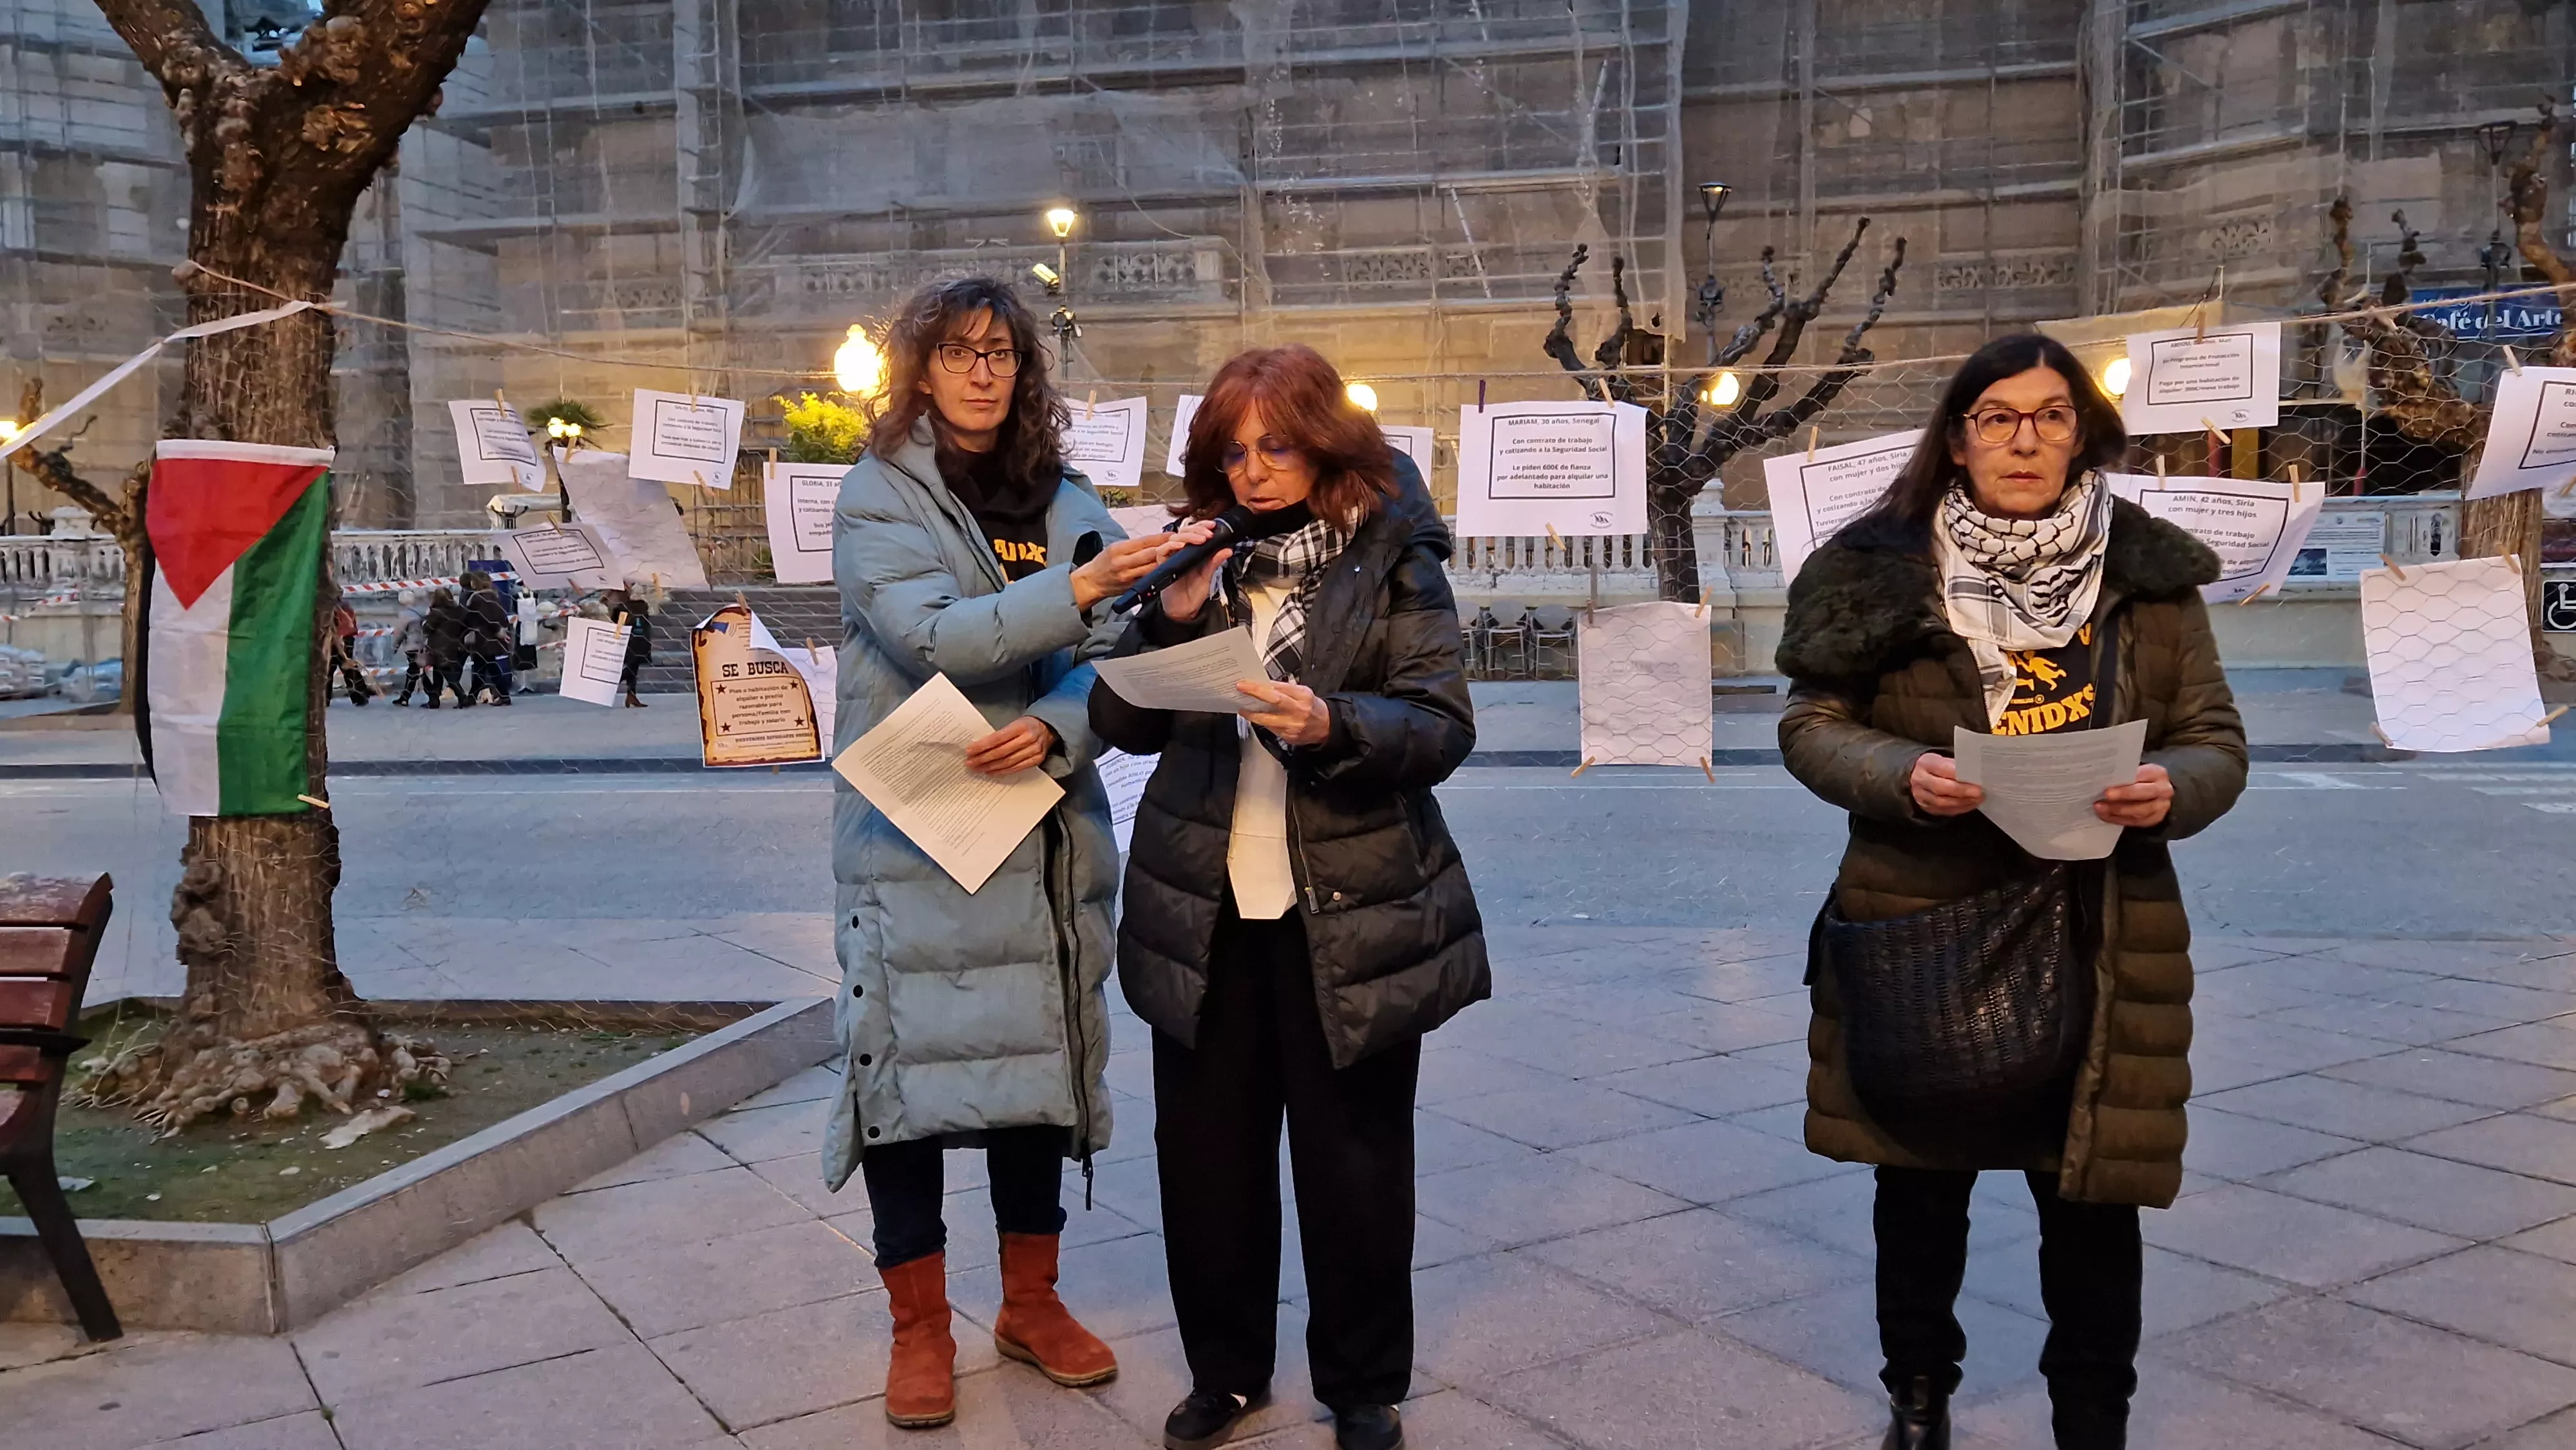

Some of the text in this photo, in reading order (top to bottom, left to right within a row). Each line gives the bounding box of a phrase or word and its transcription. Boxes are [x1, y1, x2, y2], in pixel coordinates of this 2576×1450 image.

[1828, 462, 1856, 472] FAISAL,
[1868, 455, 1888, 464] años,
[1845, 470, 1868, 479] mujer
[1844, 488, 1876, 498] contrato
[2211, 497, 2233, 506] años,
[1823, 502, 1858, 513] cotizando
[2237, 509, 2257, 518] hijos
[2226, 530, 2255, 540] trabajo
[2206, 538, 2246, 547] Seguridad
[722, 661, 790, 677] SE BUSCA
